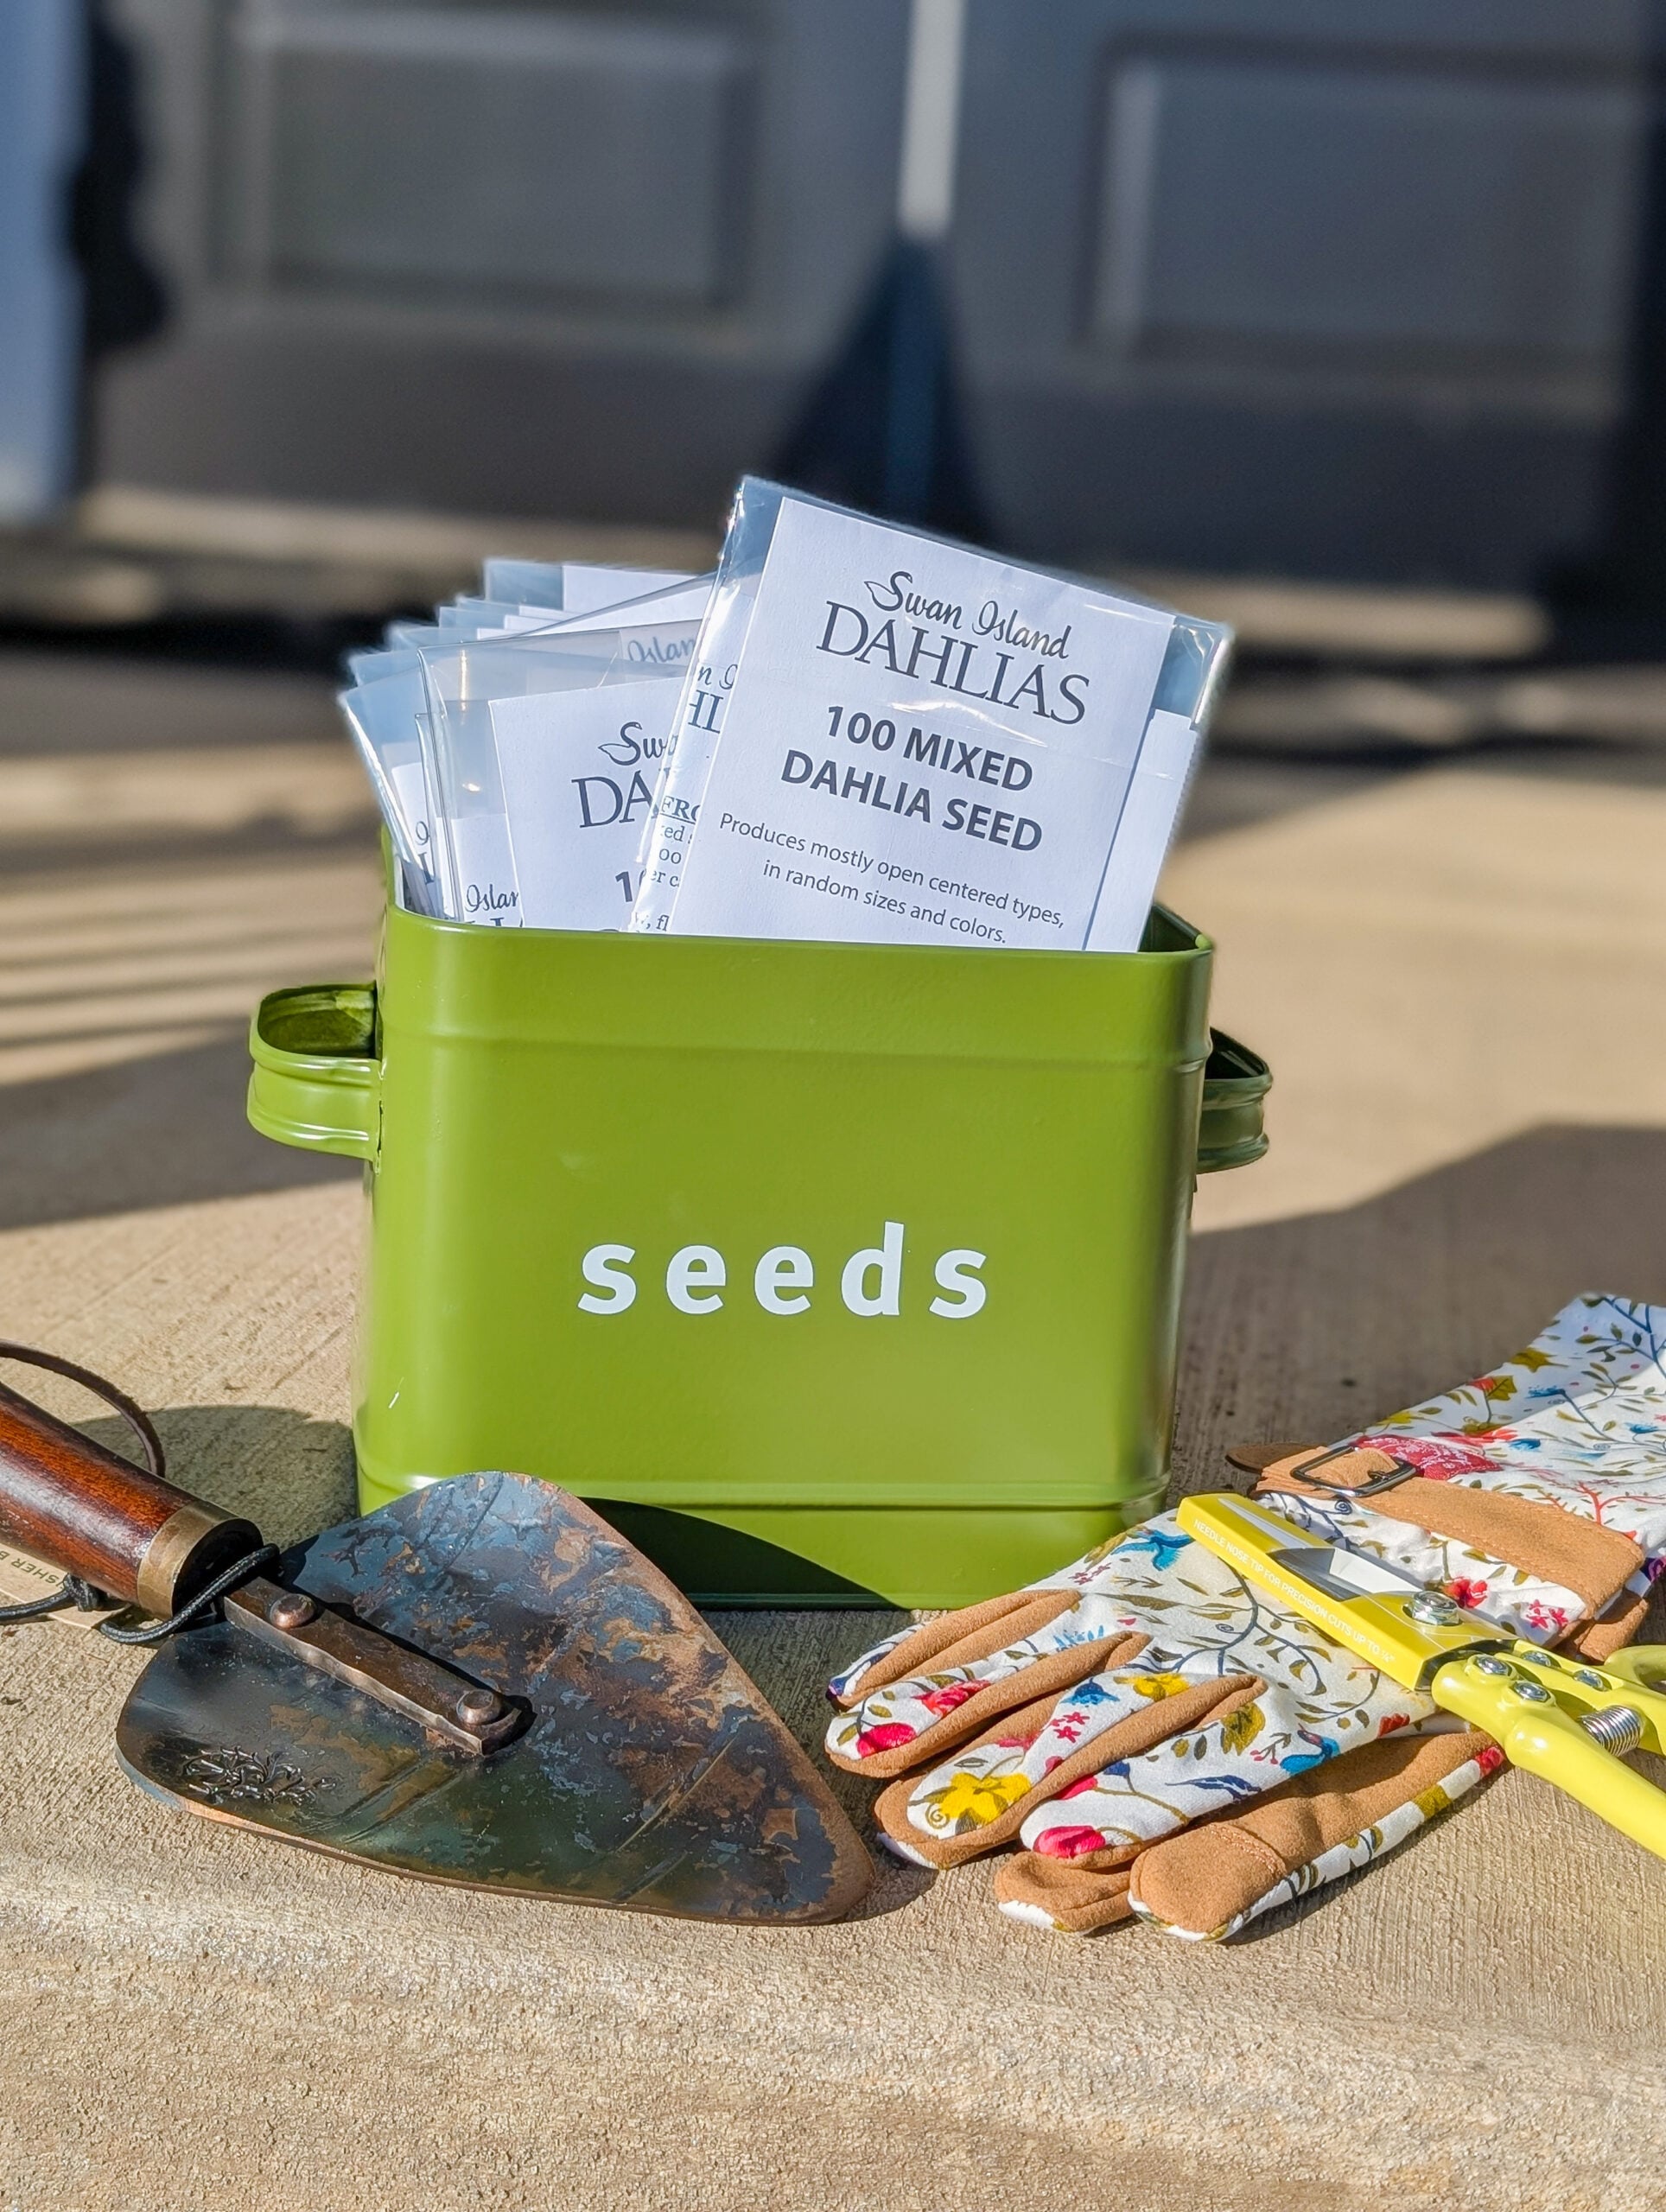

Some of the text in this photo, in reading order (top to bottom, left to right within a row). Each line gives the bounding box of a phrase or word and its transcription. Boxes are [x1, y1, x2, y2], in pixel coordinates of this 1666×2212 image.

[816, 601, 1090, 726] DAHLIAS
[864, 570, 1072, 660] Swan Island
[826, 705, 1033, 792] 100 MIXED
[781, 749, 1043, 853] DAHLIA SEED
[720, 812, 1065, 930] Produces mostly open centered types,
[763, 859, 1007, 944] in random sizes and colors.
[578, 1220, 987, 1319] seeds
[10, 1558, 66, 1589] ISHER
[1193, 1520, 1226, 1548] NEEDLE
[1226, 1542, 1249, 1565] NOSE
[1250, 1557, 1264, 1573] TIP
[1264, 1568, 1281, 1588] FOR
[1281, 1580, 1328, 1618] PRECISION
[1328, 1614, 1351, 1637] CUTS
[1352, 1629, 1368, 1646] UP
[1366, 1638, 1382, 1656] TO
